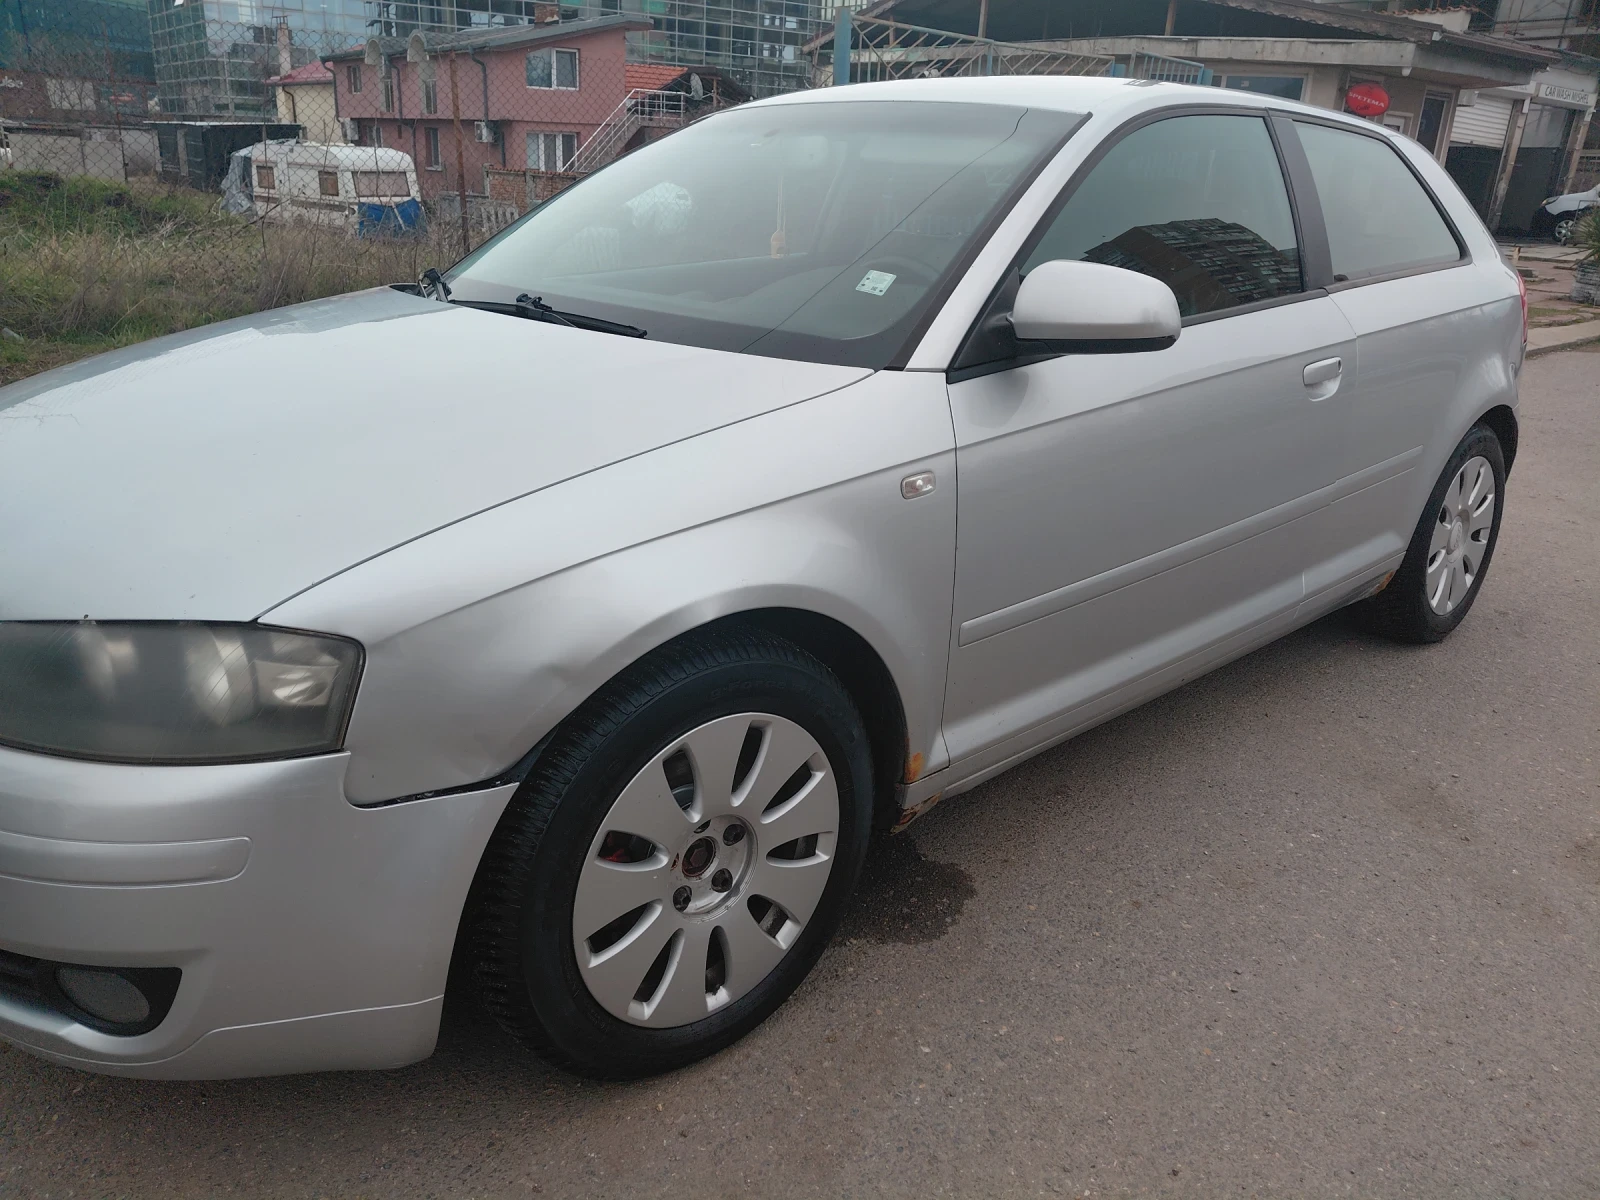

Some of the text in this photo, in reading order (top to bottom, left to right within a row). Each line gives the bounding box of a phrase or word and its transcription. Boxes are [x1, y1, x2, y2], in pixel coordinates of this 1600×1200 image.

[1349, 92, 1384, 107] SPETEMA
[1545, 86, 1556, 97] CAR
[1556, 88, 1571, 100] WASH
